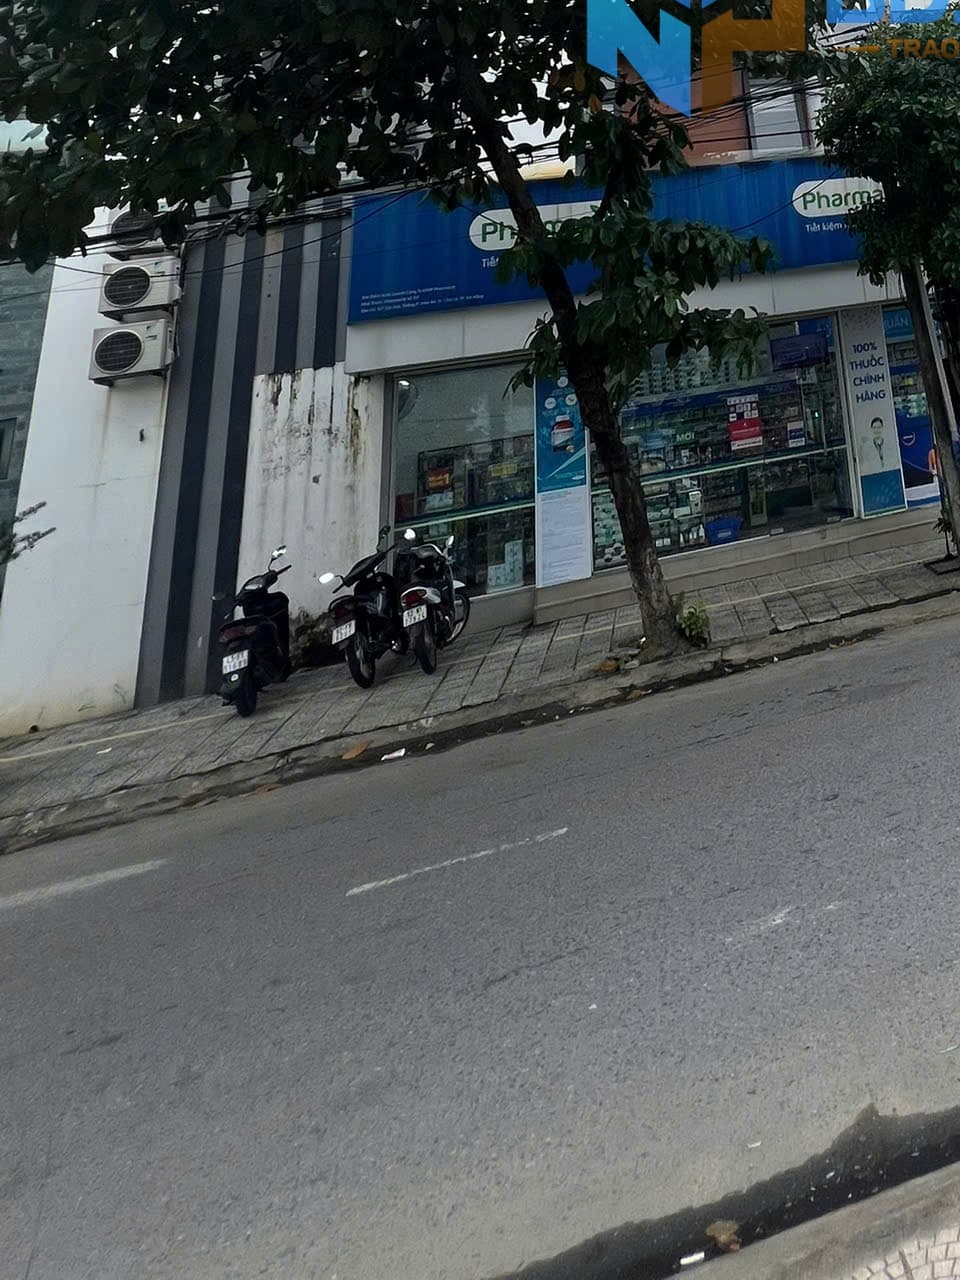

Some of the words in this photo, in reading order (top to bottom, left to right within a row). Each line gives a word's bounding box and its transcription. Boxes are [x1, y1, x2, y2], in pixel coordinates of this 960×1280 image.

[802, 189, 882, 210] Pharma
[482, 256, 499, 268] Tiế
[853, 342, 877, 353] 100%
[850, 355, 885, 371] THUỐC
